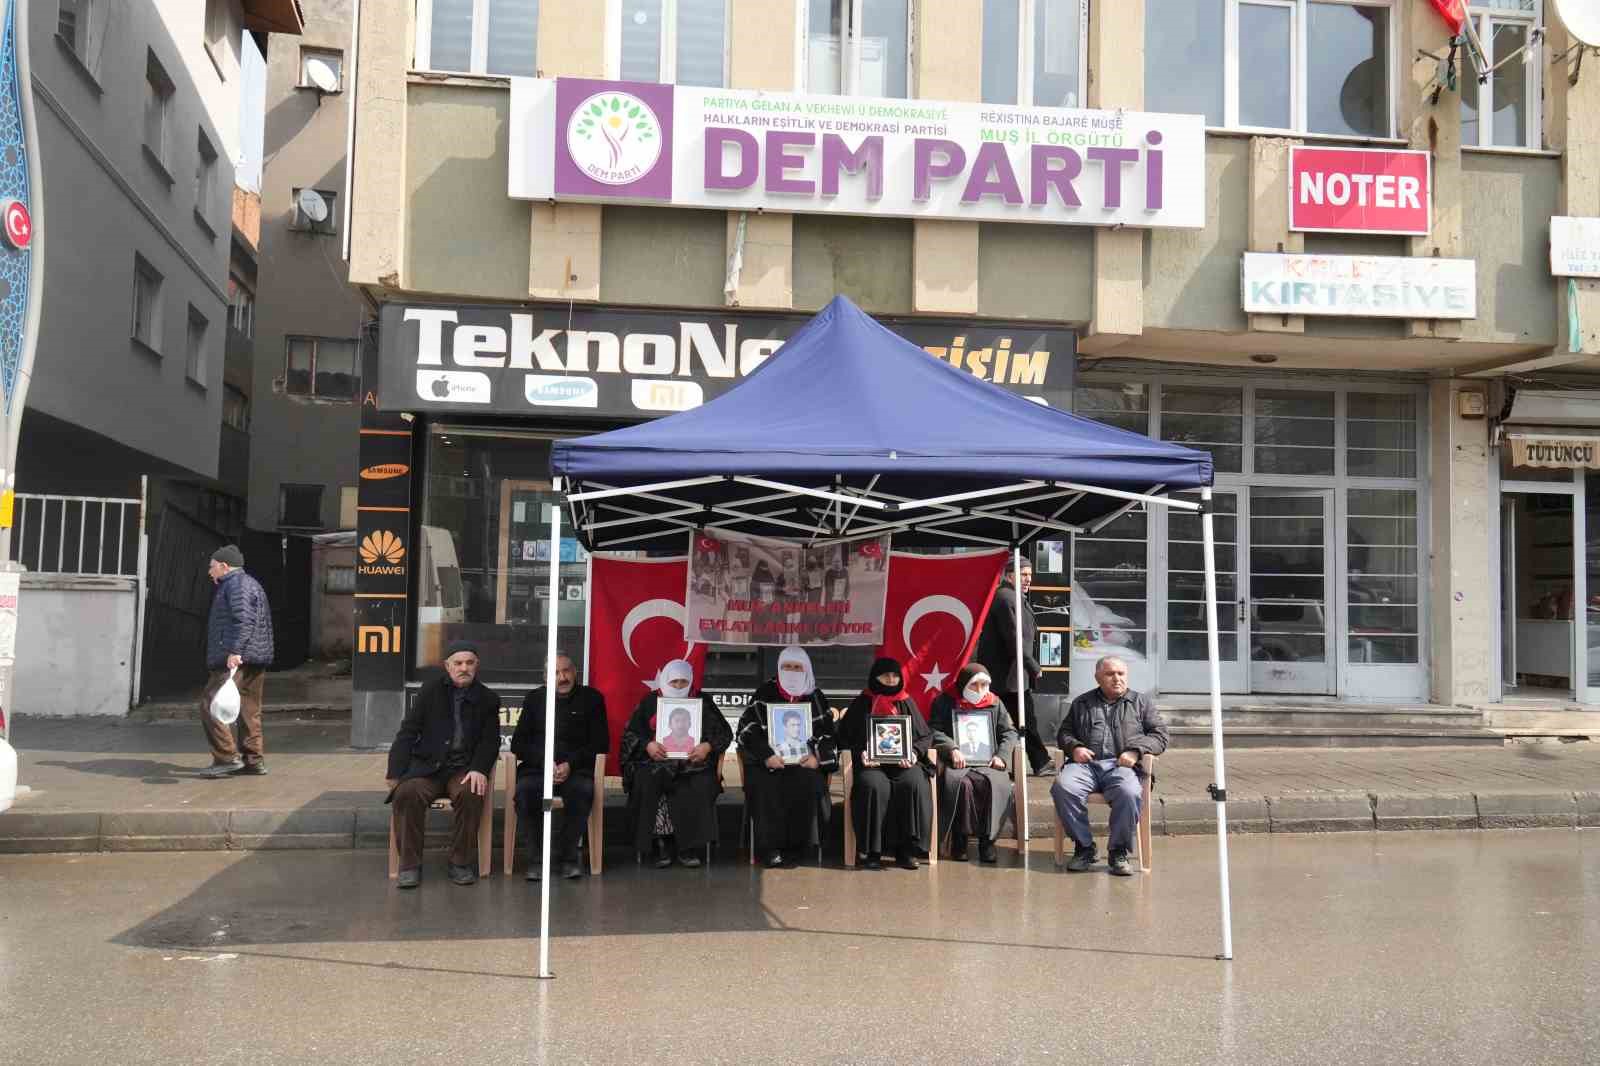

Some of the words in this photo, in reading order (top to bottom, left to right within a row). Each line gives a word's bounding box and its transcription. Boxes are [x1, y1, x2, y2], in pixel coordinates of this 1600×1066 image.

[703, 113, 770, 127] HALKLARIN
[818, 119, 833, 130] VE
[704, 126, 884, 201] DEM
[912, 129, 1164, 210] PARTİ
[1300, 171, 1422, 209] NOTER
[1525, 440, 1593, 463] TÜTÜNCÜ
[357, 565, 405, 576] HUAWEI
